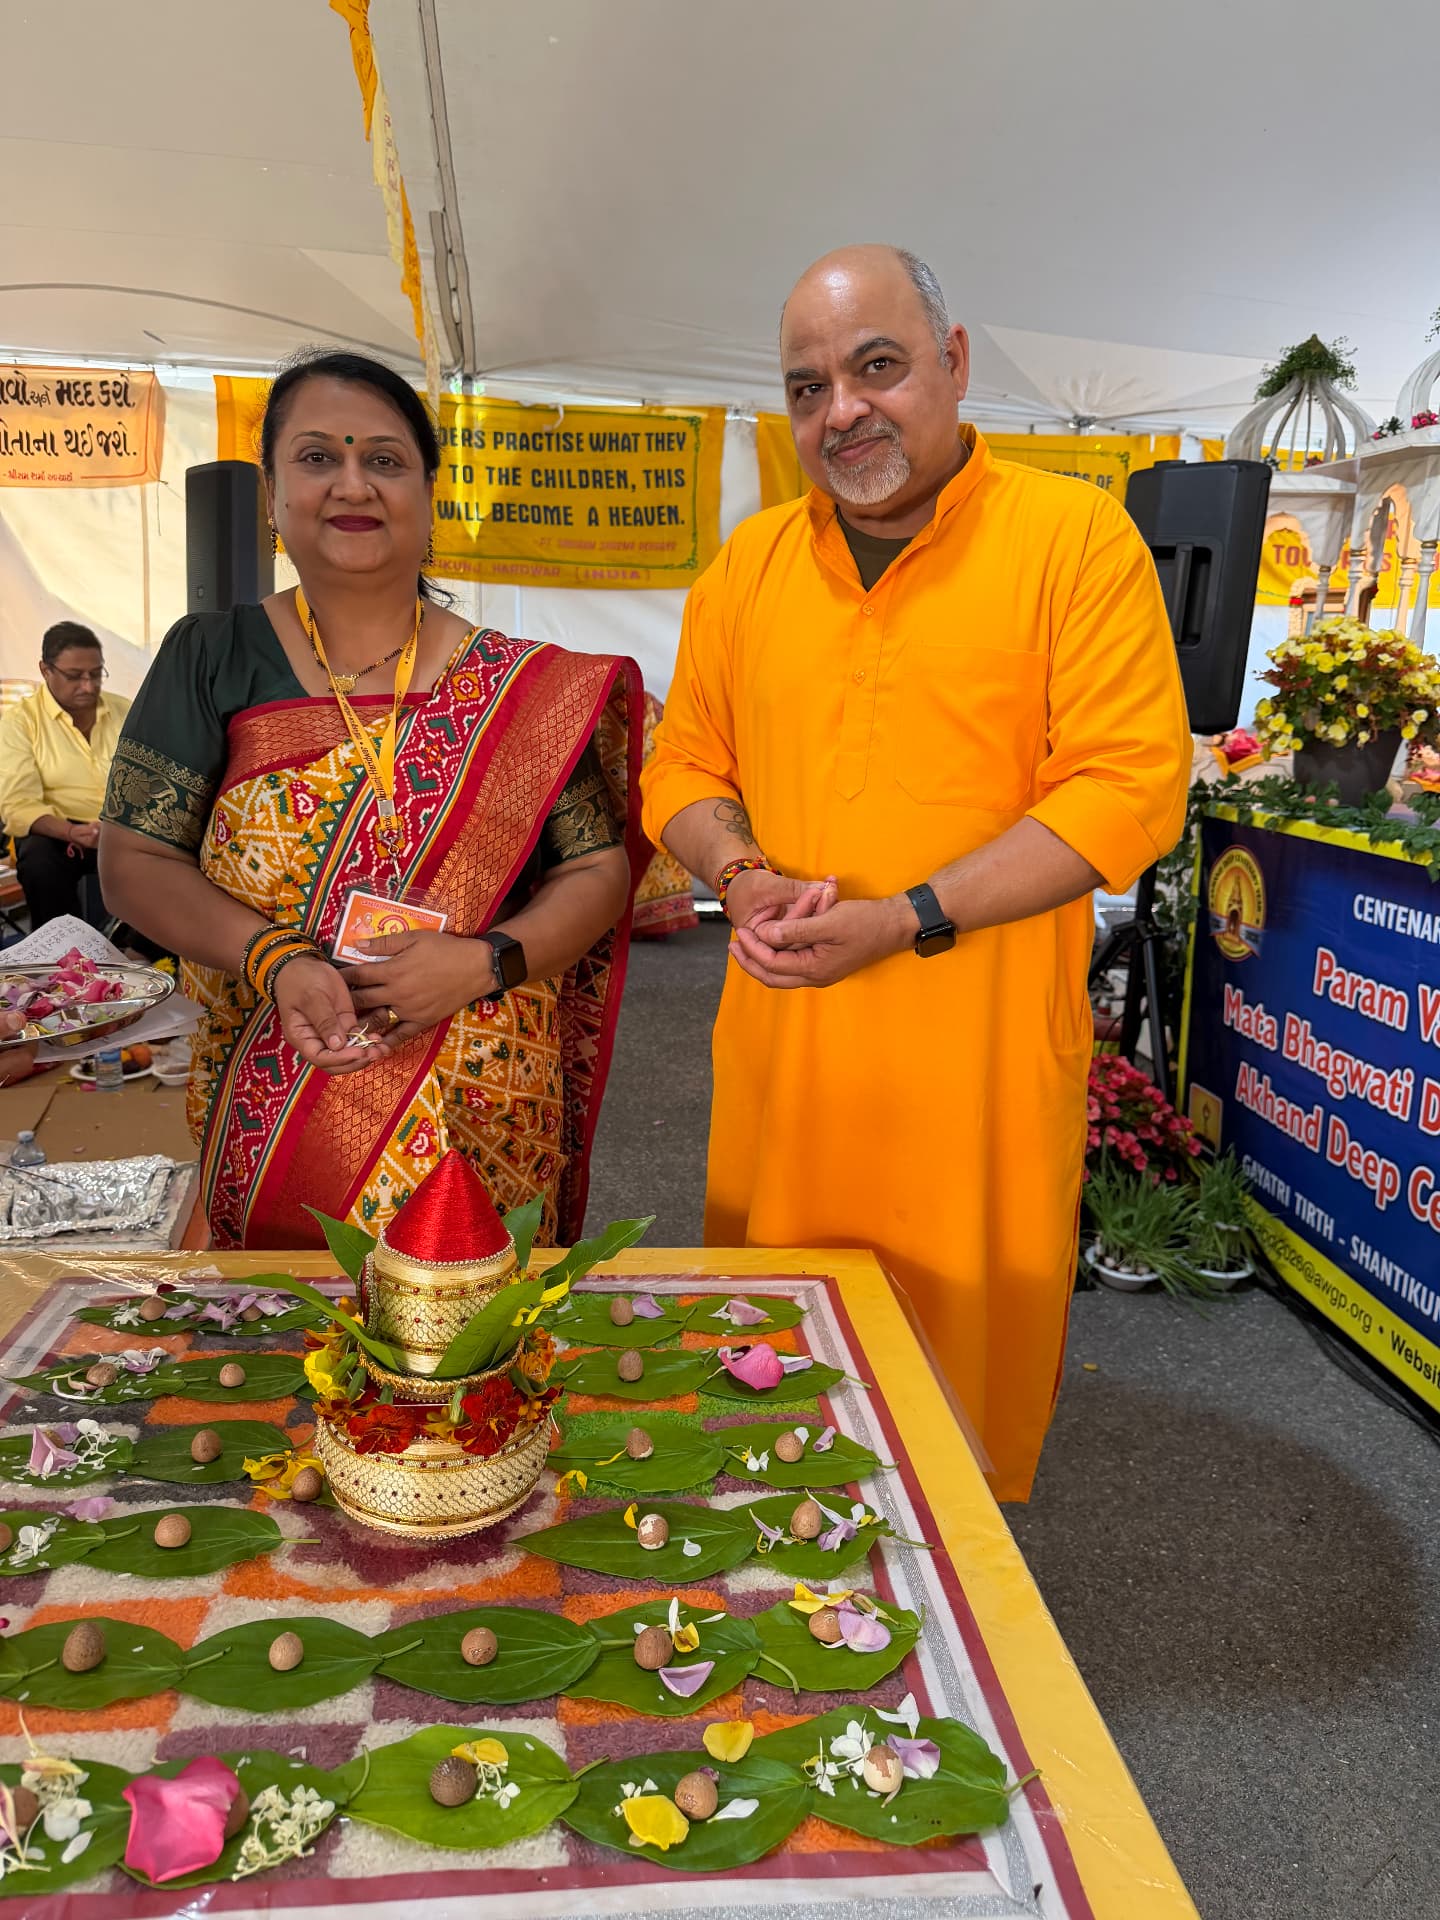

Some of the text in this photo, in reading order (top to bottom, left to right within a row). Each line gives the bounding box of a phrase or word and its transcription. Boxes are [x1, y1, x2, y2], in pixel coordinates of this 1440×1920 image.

[56, 379, 95, 407] મદદ
[0, 418, 59, 457] ોતાના
[440, 426, 687, 453] DERS PRACTISE WHAT THEY
[448, 464, 686, 493] TO THE CHILDREN, THIS
[437, 500, 685, 527] WILL BECOME A HEAVEN.
[1353, 893, 1440, 945] CENTENAR
[1312, 946, 1409, 1032] Param
[1223, 982, 1440, 1136] Mata Bhagwati D
[1235, 1061, 1440, 1233] Akhand Deep Ce
[1241, 1154, 1291, 1208] GAYATRI
[1294, 1190, 1335, 1245] TIRTH
[1349, 1234, 1440, 1324] SHANTIKUN
[1390, 1330, 1440, 1390] Websit
